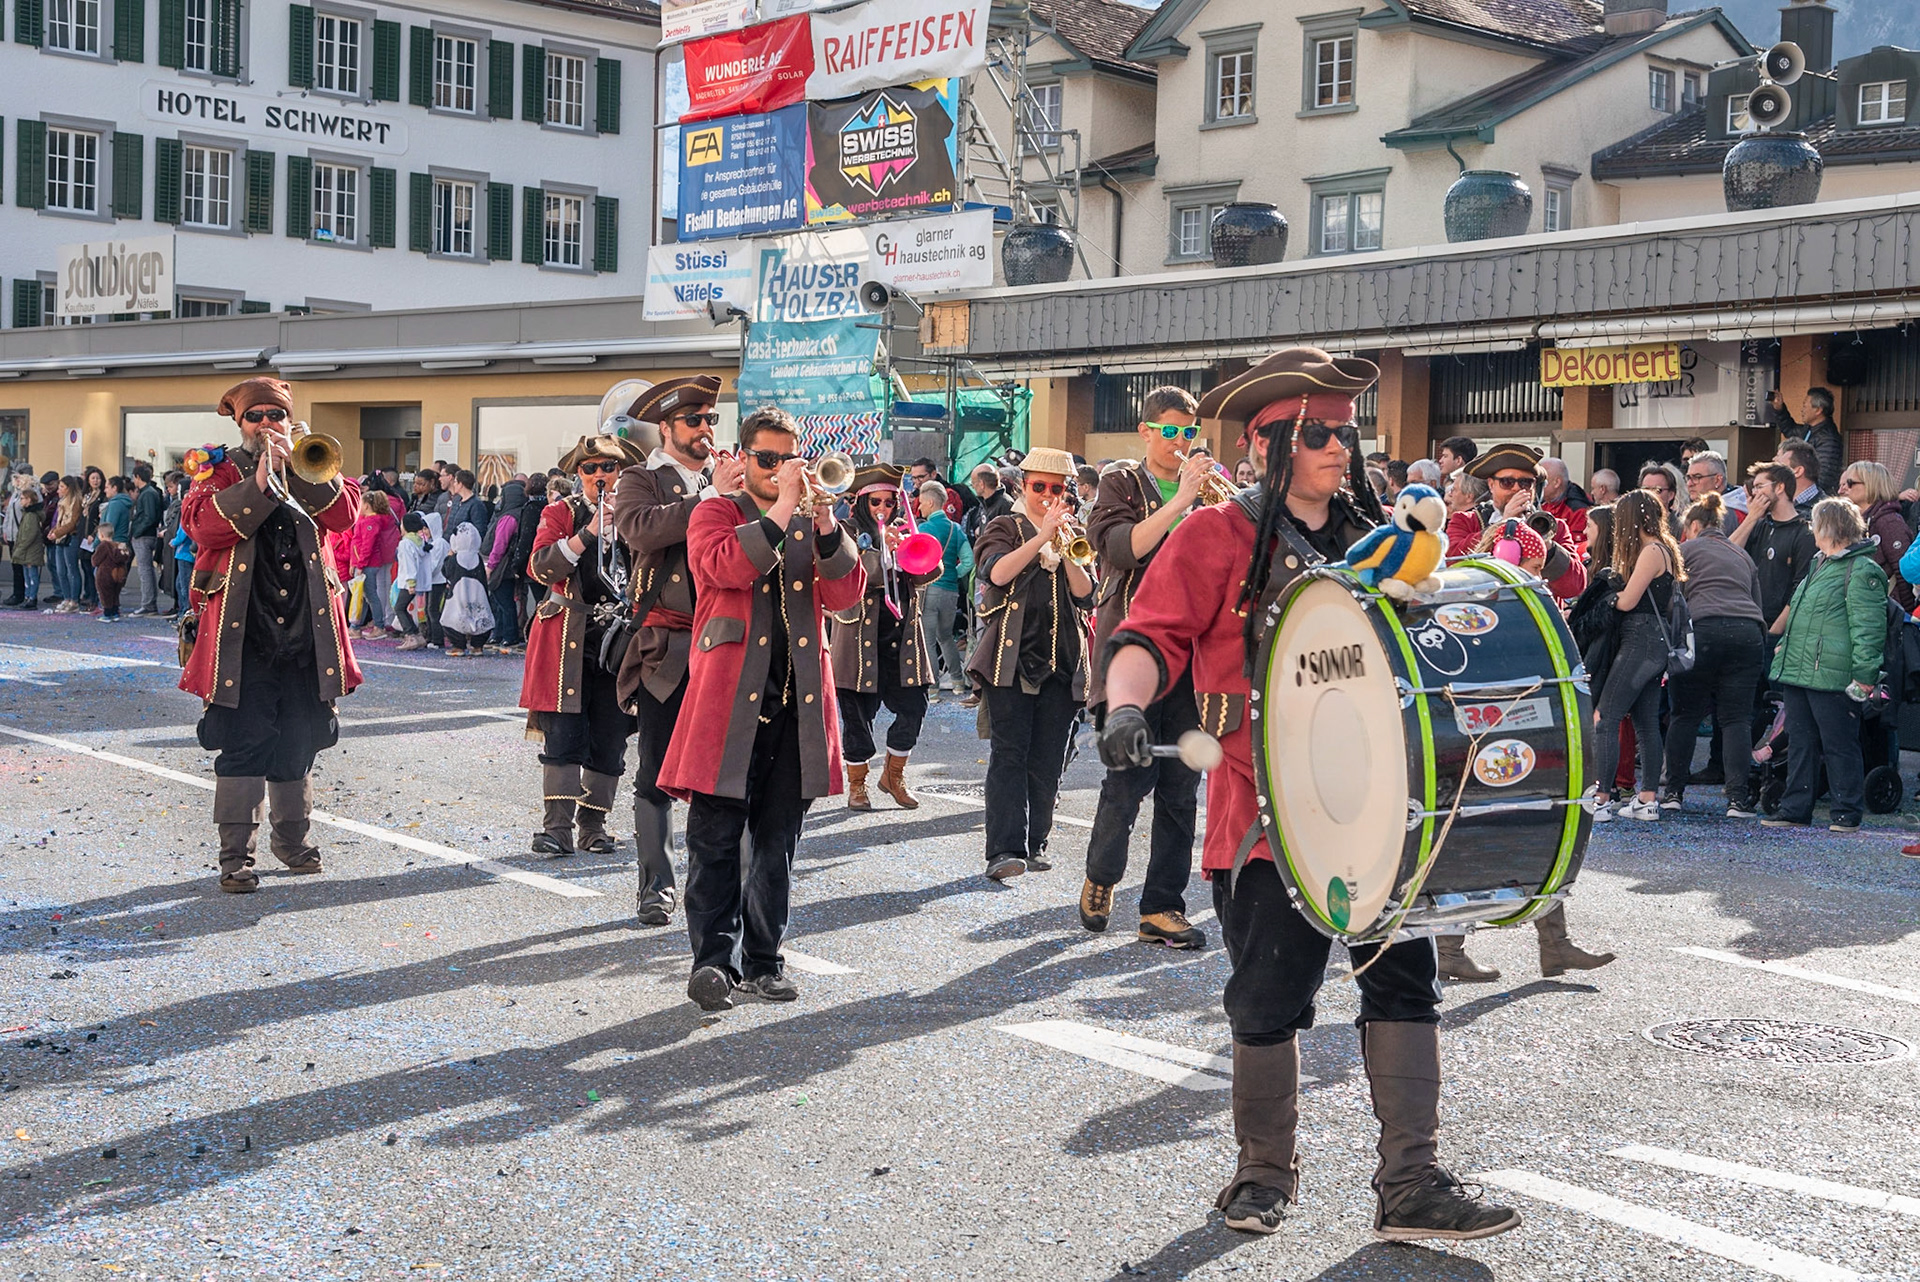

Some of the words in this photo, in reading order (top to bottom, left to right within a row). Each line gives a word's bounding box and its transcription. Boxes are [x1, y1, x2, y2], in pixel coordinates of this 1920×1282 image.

[824, 8, 975, 75] RAIFFEISEN
[705, 54, 765, 82] WUNDERLE
[768, 49, 783, 68] AG
[778, 70, 805, 81] SOLAR
[158, 89, 246, 124] HOTEL
[265, 106, 391, 144] SCHWERT
[689, 132, 721, 162] FA
[843, 123, 914, 155] SWISS
[730, 152, 739, 160] Fax
[843, 145, 914, 166] WERBETECHNIK
[704, 172, 714, 184] Ihr
[714, 167, 767, 183] Ansprechpartner
[767, 162, 777, 174] für
[709, 187, 738, 202] gesamte
[738, 179, 783, 196] Gebäudehülle
[685, 209, 714, 233] Fischli
[716, 203, 781, 228] Bedachungen
[782, 198, 798, 220] AG
[809, 188, 951, 220] swiss-werbetechnik.ch
[916, 228, 954, 247] glarner
[675, 250, 728, 271] Stüssi
[899, 244, 966, 264] haustechnik
[969, 244, 986, 260] ag
[65, 242, 164, 310] schubiger
[768, 262, 860, 296] HAUSER
[893, 269, 961, 285] glarner-haustechnik.ch
[137, 298, 159, 309] Näfels
[674, 282, 724, 302] Näfels
[65, 302, 96, 313] Kaufhaus
[771, 290, 861, 321] HOLZBA
[747, 334, 838, 360] casa-technica.ch
[1747, 337, 1758, 364] BAR
[770, 364, 800, 378] Landolt
[799, 361, 857, 377] Gebäudetechnik
[858, 360, 870, 374] AG
[1543, 344, 1677, 384] Dekoriert
[1745, 376, 1757, 420] BISTRO
[1309, 644, 1366, 685] SONOR
